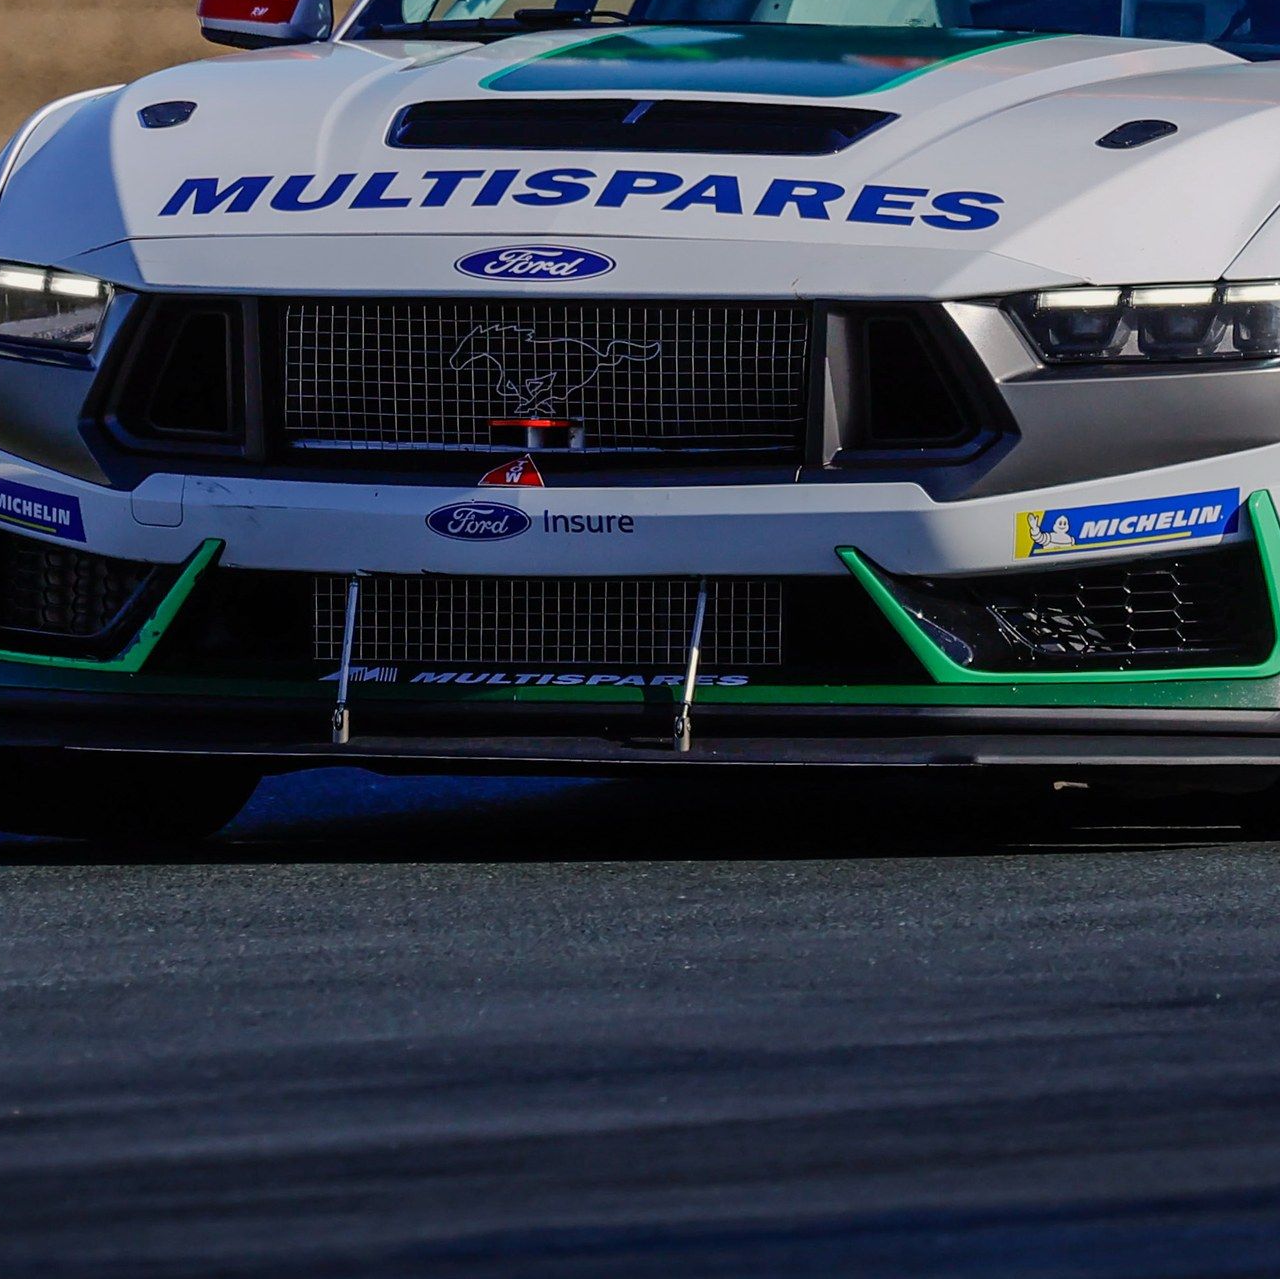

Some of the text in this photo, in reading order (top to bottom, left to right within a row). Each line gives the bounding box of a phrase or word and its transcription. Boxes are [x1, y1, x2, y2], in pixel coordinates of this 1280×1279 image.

[158, 168, 1006, 231] MULTISPARES
[484, 249, 585, 276] Ford
[447, 507, 635, 535] Ford Insure
[1079, 505, 1222, 539] MICHELIN
[410, 673, 750, 686] MULTISPARES
